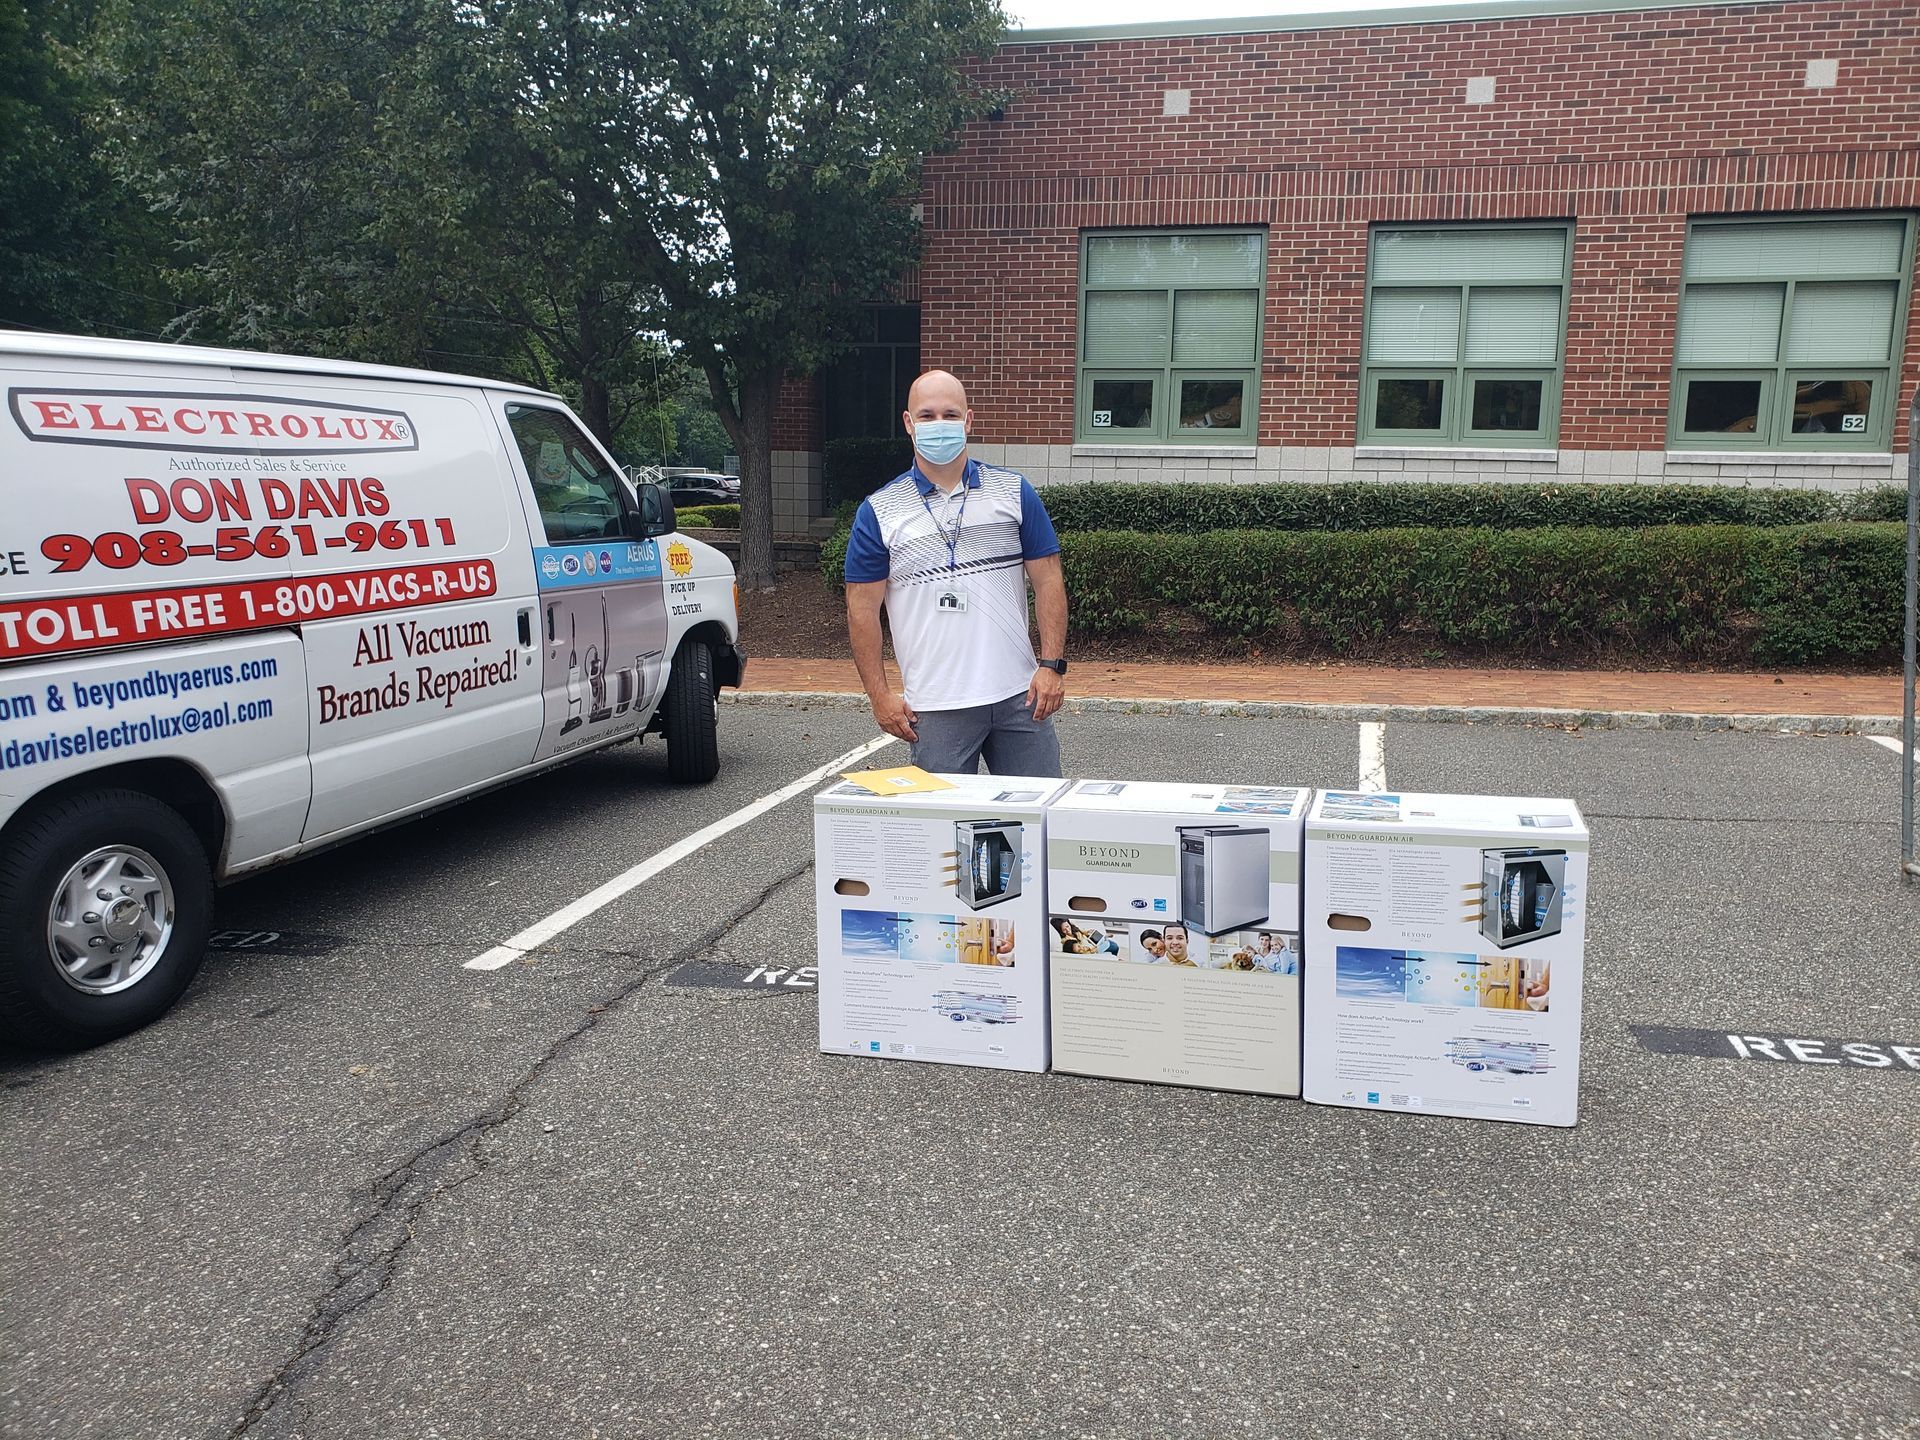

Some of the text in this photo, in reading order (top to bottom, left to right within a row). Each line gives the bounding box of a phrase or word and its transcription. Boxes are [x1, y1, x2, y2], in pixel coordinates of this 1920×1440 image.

[1094, 413, 1110, 424] 52
[1843, 417, 1864, 429] 52
[168, 457, 347, 472] Authorized Sales & Service
[124, 477, 391, 525] DON DAVIS
[41, 517, 456, 574] 908-561-9611
[627, 545, 655, 563] AERUS
[670, 552, 690, 566] FREE
[671, 582, 696, 593] PICK UP
[0, 564, 491, 649] TOLL FREE 1-800-VACS-R-US
[672, 603, 702, 616] DELIVERY
[352, 617, 491, 668] All Vacuum
[47, 684, 66, 713] &
[74, 657, 278, 708] beyondbyaerus.com
[317, 648, 519, 726] Brands Repaired!
[0, 698, 273, 770] daviselectrolux@aol.com
[856, 808, 888, 816] GUARDIAN
[1359, 834, 1399, 843] GUARDIAN
[1079, 845, 1140, 859] BEYOND
[1086, 859, 1120, 867] GUARDIAN
[1401, 931, 1432, 939] BEYOND
